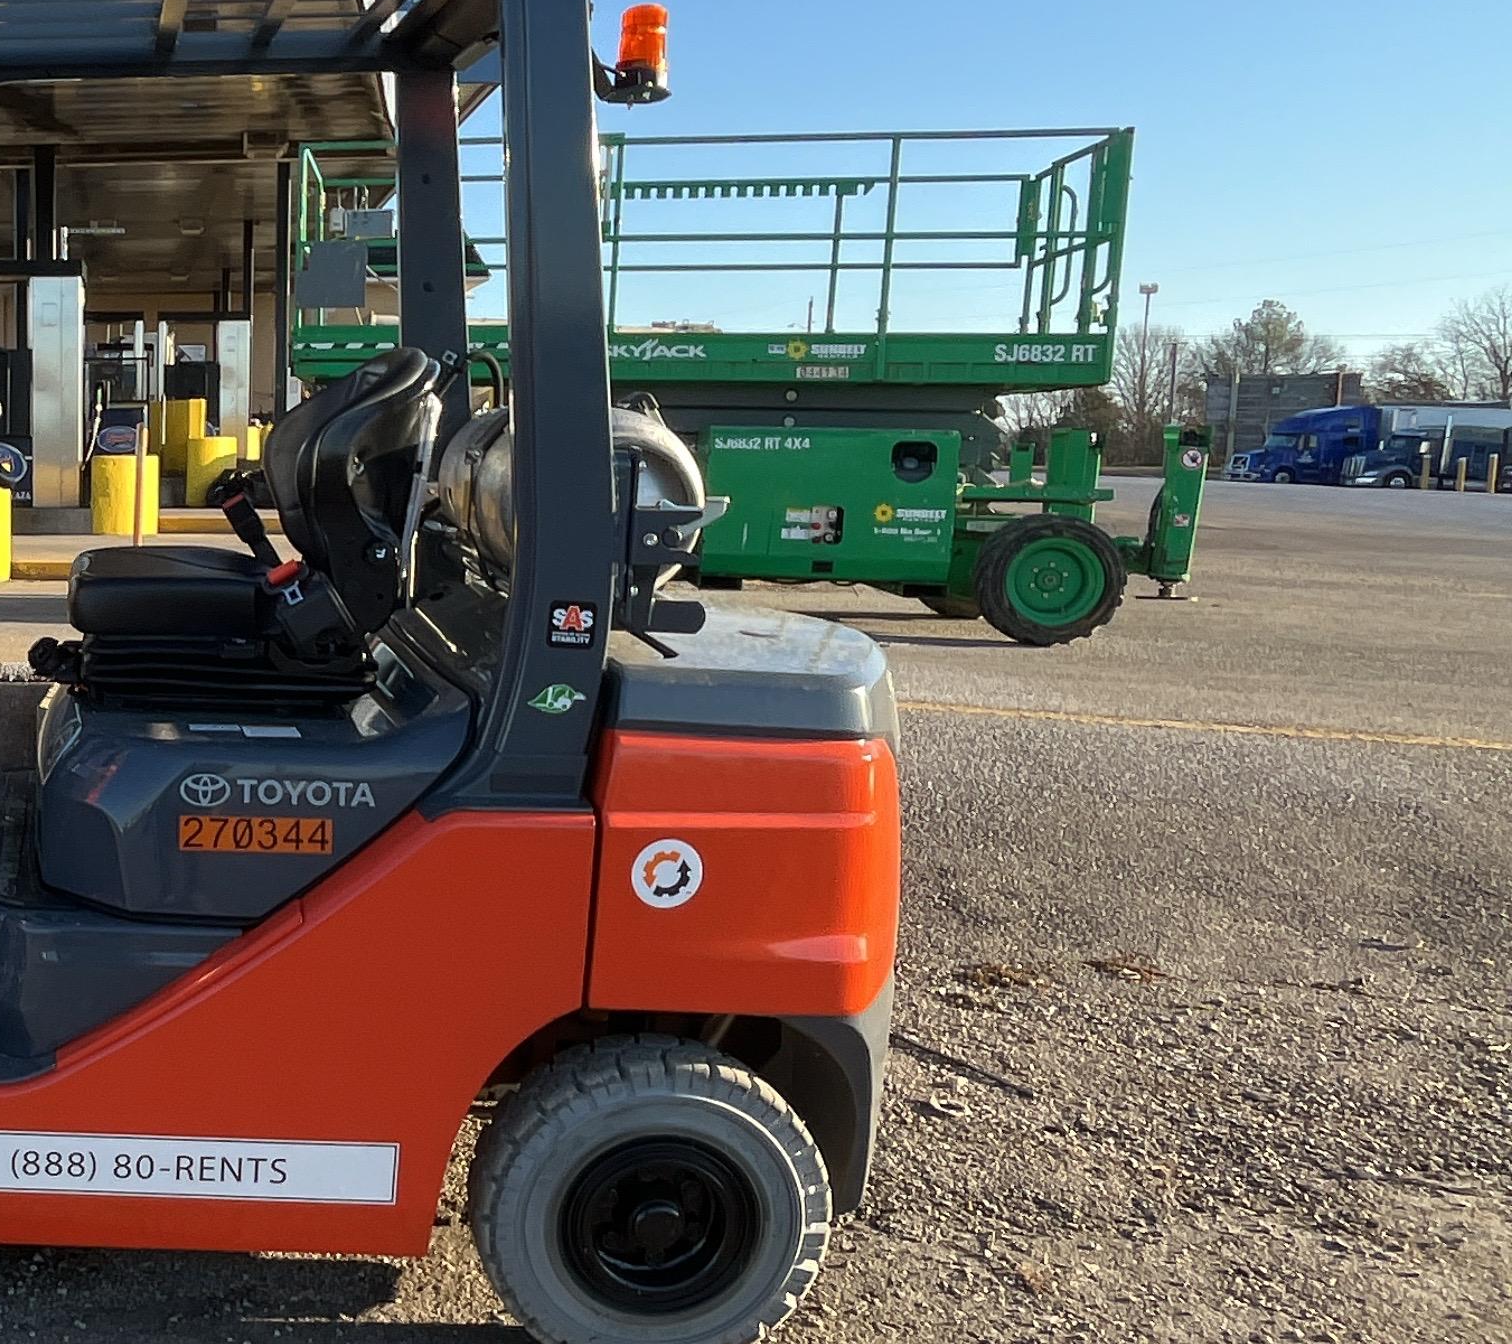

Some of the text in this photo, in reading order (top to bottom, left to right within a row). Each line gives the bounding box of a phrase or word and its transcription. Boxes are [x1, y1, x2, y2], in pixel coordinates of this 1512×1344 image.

[994, 343, 1098, 363] SJ6832 RT
[764, 437, 782, 450] RT
[551, 605, 594, 632] SAS
[236, 778, 376, 808] TOYOTA
[182, 816, 329, 852] 270344
[10, 1148, 288, 1185] (888) 80-RENTS
